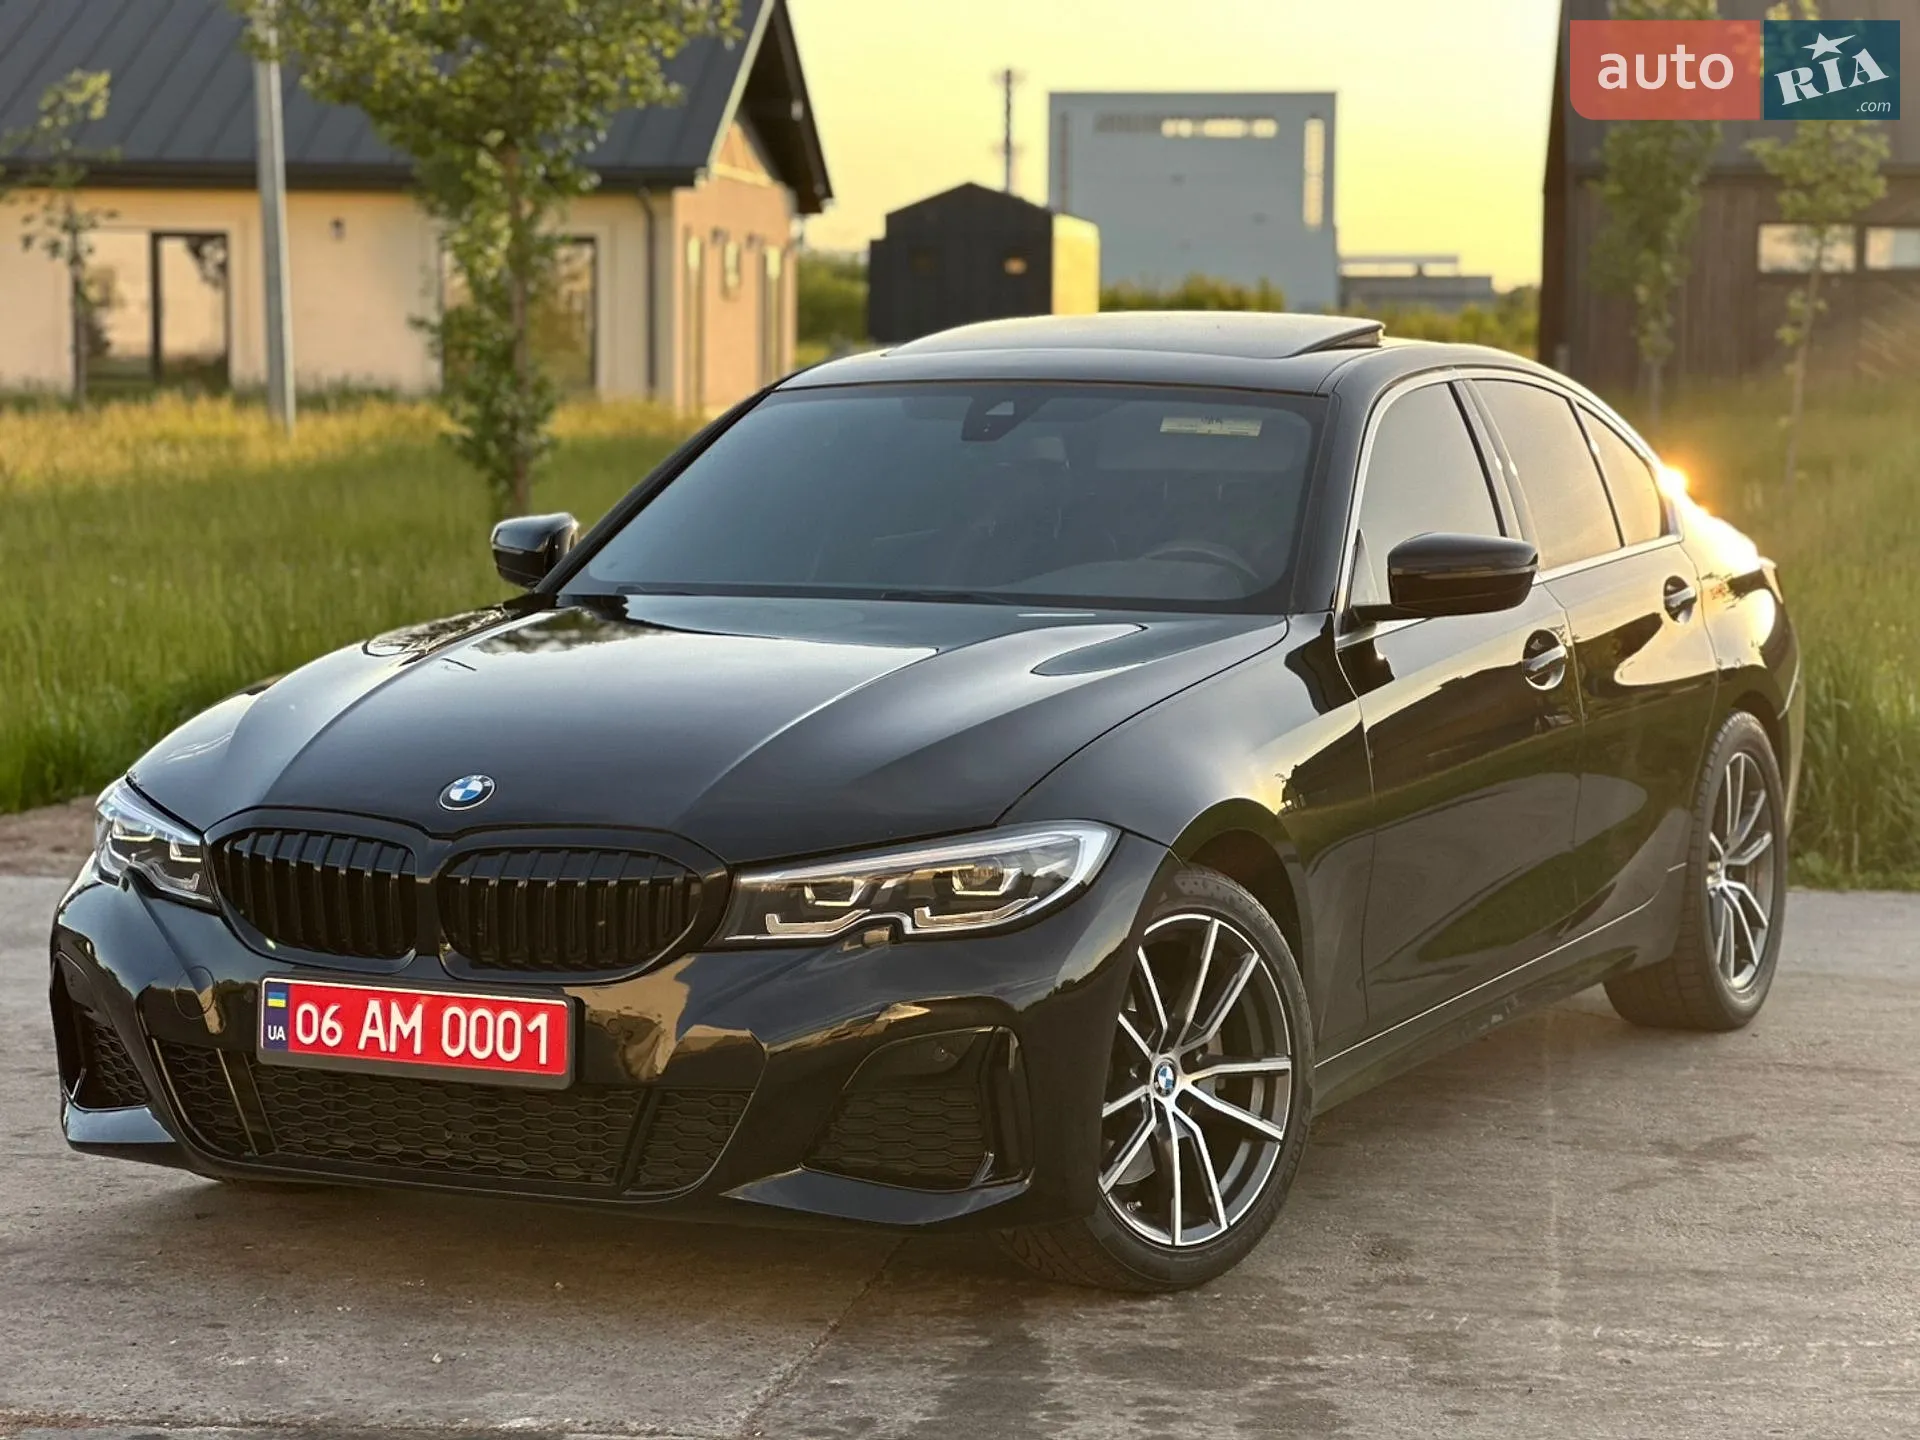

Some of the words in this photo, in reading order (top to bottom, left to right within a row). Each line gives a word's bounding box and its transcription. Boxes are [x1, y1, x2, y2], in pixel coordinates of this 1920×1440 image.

[267, 1025, 286, 1041] UA
[295, 1002, 343, 1047] 06
[356, 999, 423, 1055] AM
[441, 1006, 549, 1065] 0001
